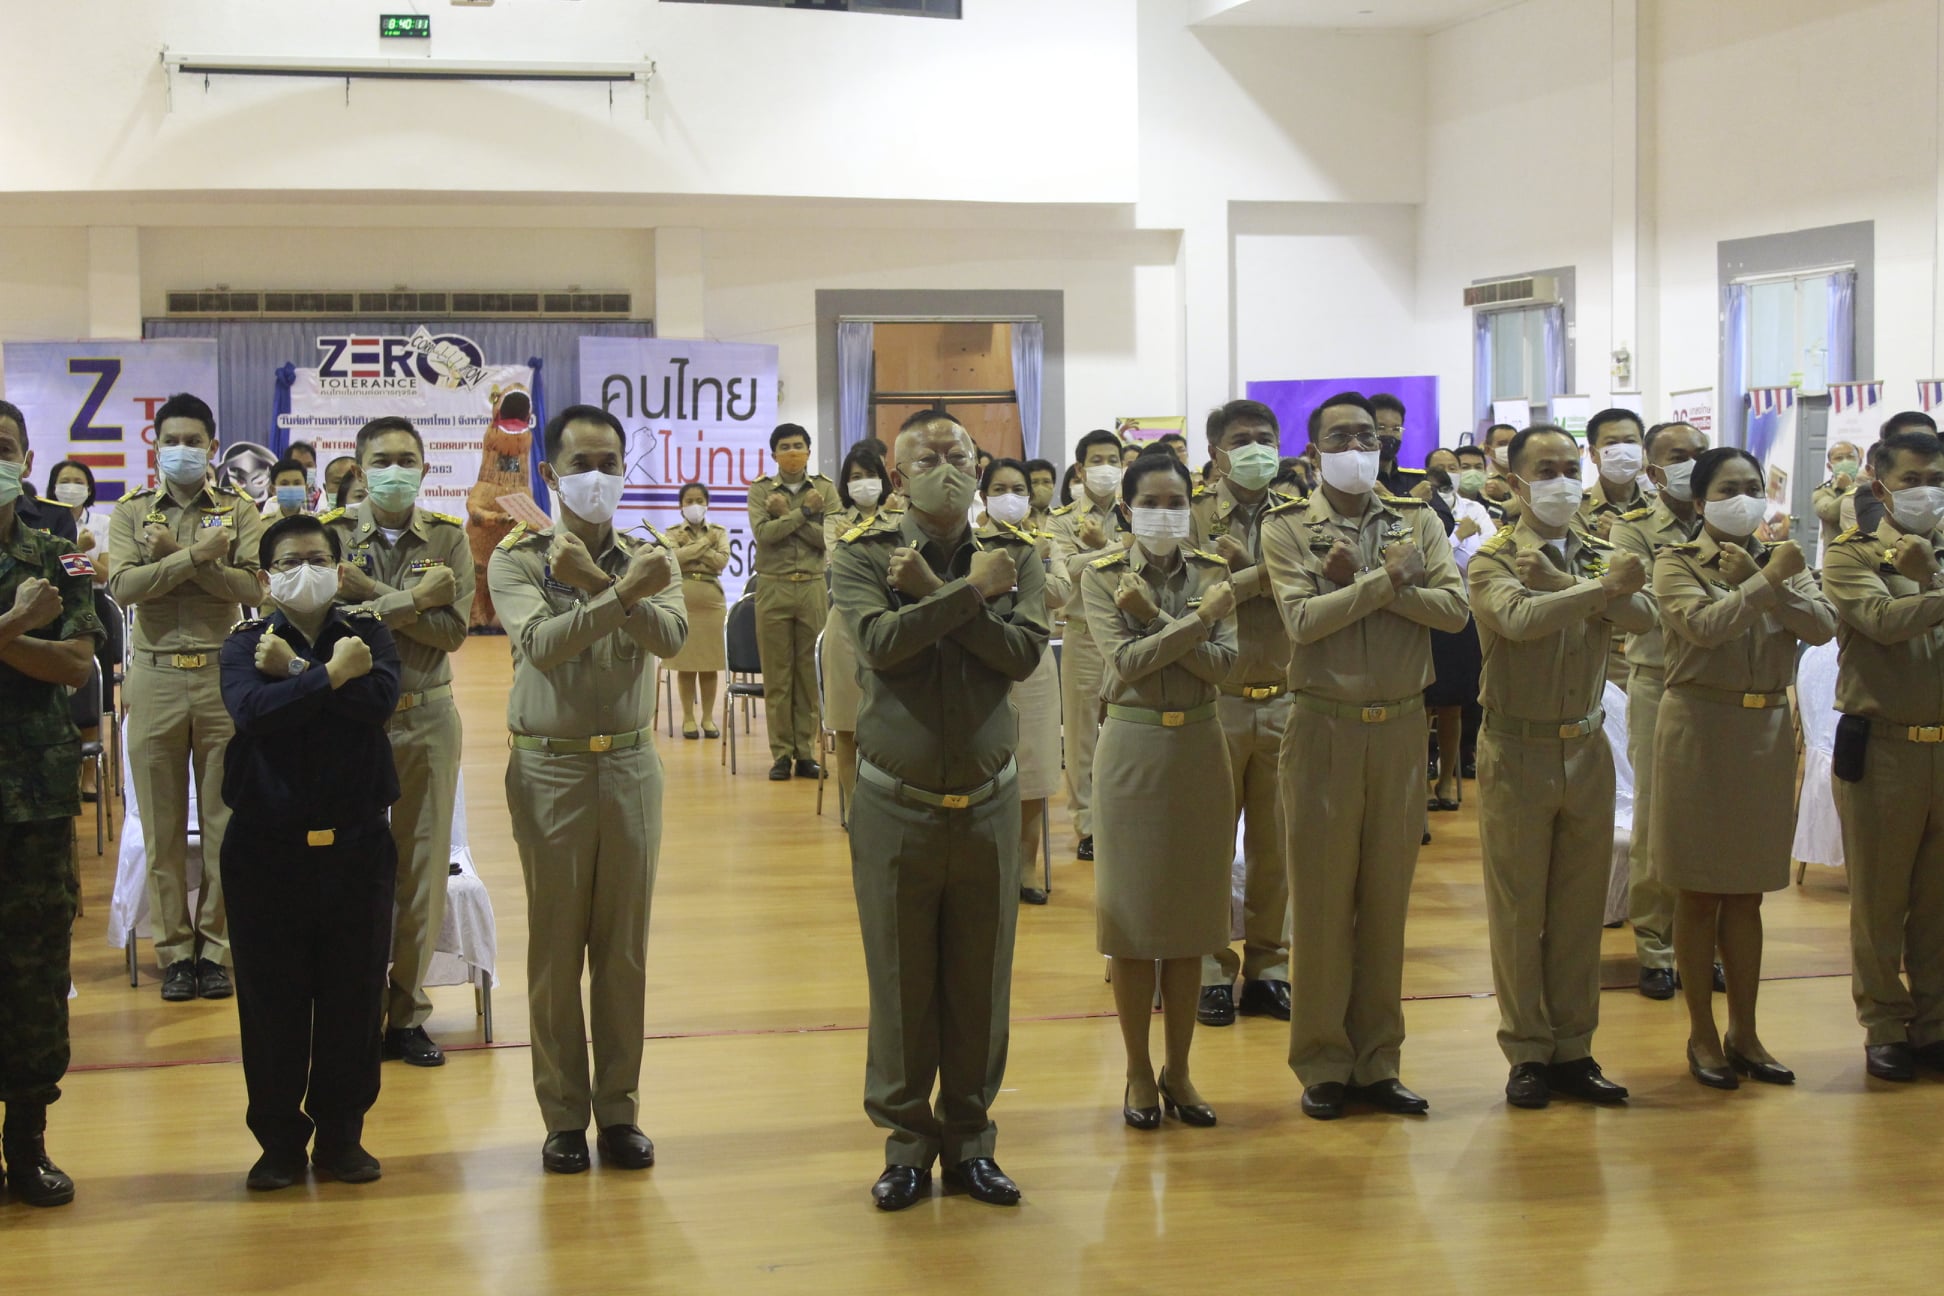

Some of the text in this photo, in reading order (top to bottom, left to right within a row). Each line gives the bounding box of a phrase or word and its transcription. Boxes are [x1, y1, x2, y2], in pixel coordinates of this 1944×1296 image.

[320, 379, 416, 388] TOLERANCE
[602, 358, 757, 421] คนไทย
[322, 441, 357, 449] INTERN
[429, 441, 483, 450] CORRUPTIO
[658, 429, 764, 485] ไม่ทน
